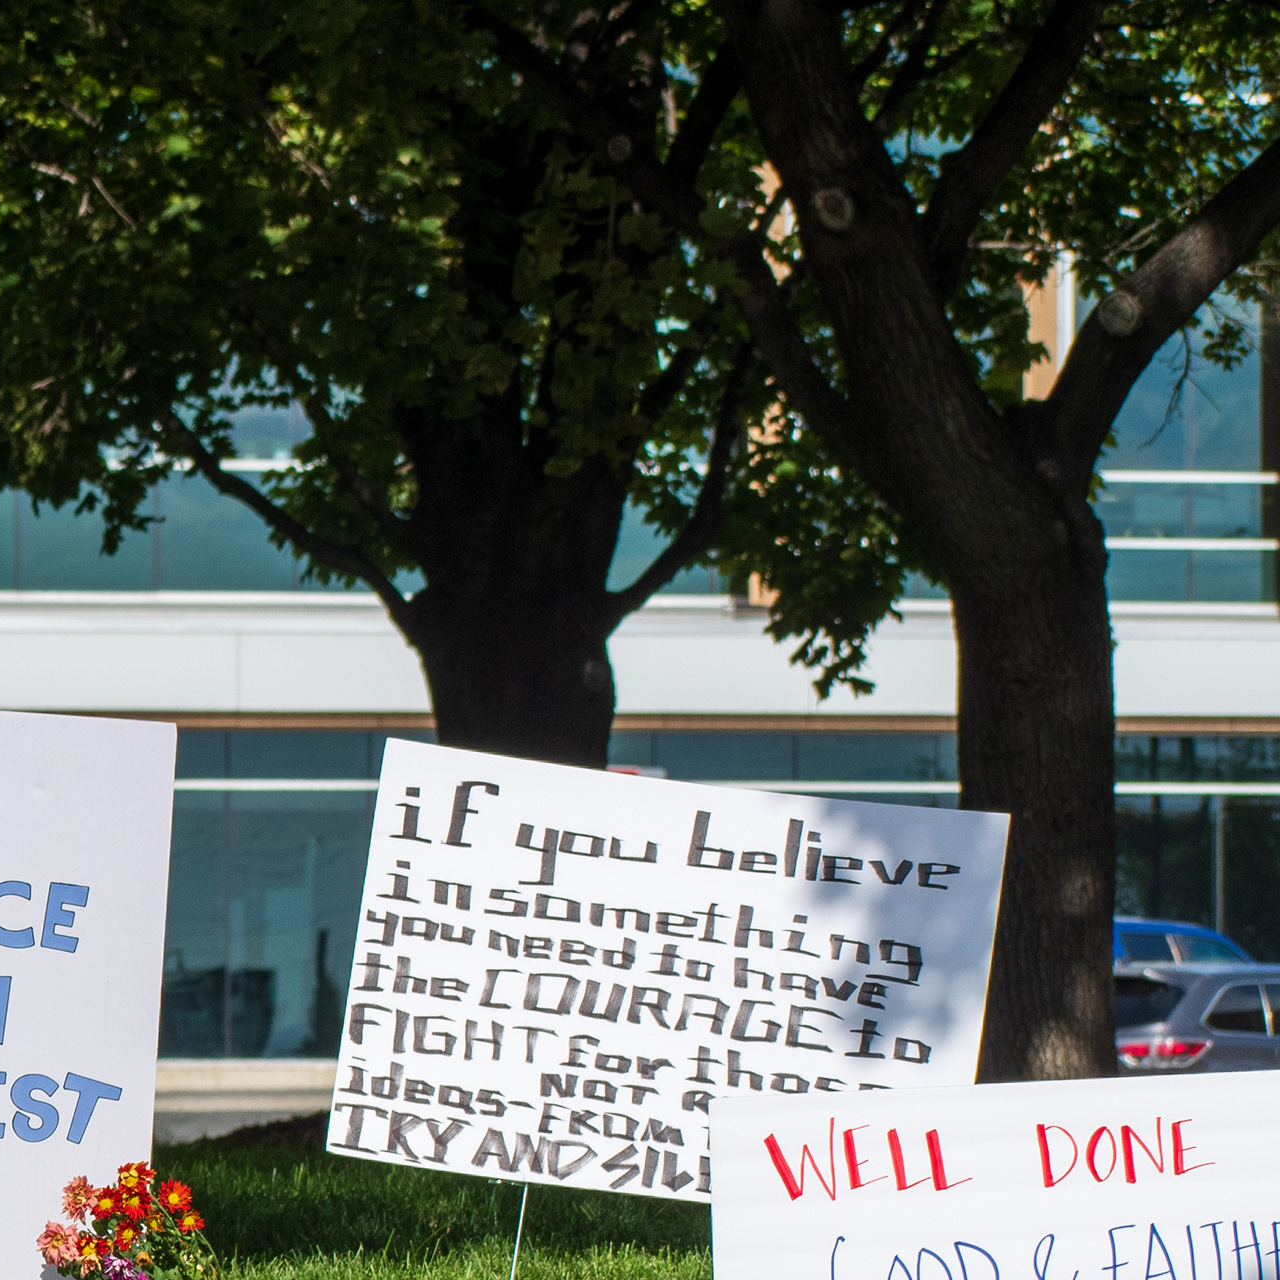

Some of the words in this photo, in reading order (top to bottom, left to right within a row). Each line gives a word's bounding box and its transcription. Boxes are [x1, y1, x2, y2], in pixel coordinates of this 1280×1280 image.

[389, 779, 500, 849] if
[515, 822, 660, 887] you
[686, 809, 961, 890] believe
[364, 909, 475, 947] you
[488, 926, 636, 971] need
[648, 943, 715, 982] to
[733, 957, 890, 1009] have
[349, 1002, 558, 1063] FIGHT
[560, 1033, 676, 1076] for
[354, 952, 469, 1002] the
[478, 967, 844, 1053] COURAGE
[845, 1017, 932, 1064] to
[540, 1071, 667, 1105] NOT
[334, 1102, 472, 1164] TRY
[472, 1128, 598, 1181] AND
[763, 1117, 973, 1201] WELL
[1036, 1117, 1216, 1188] DONE
